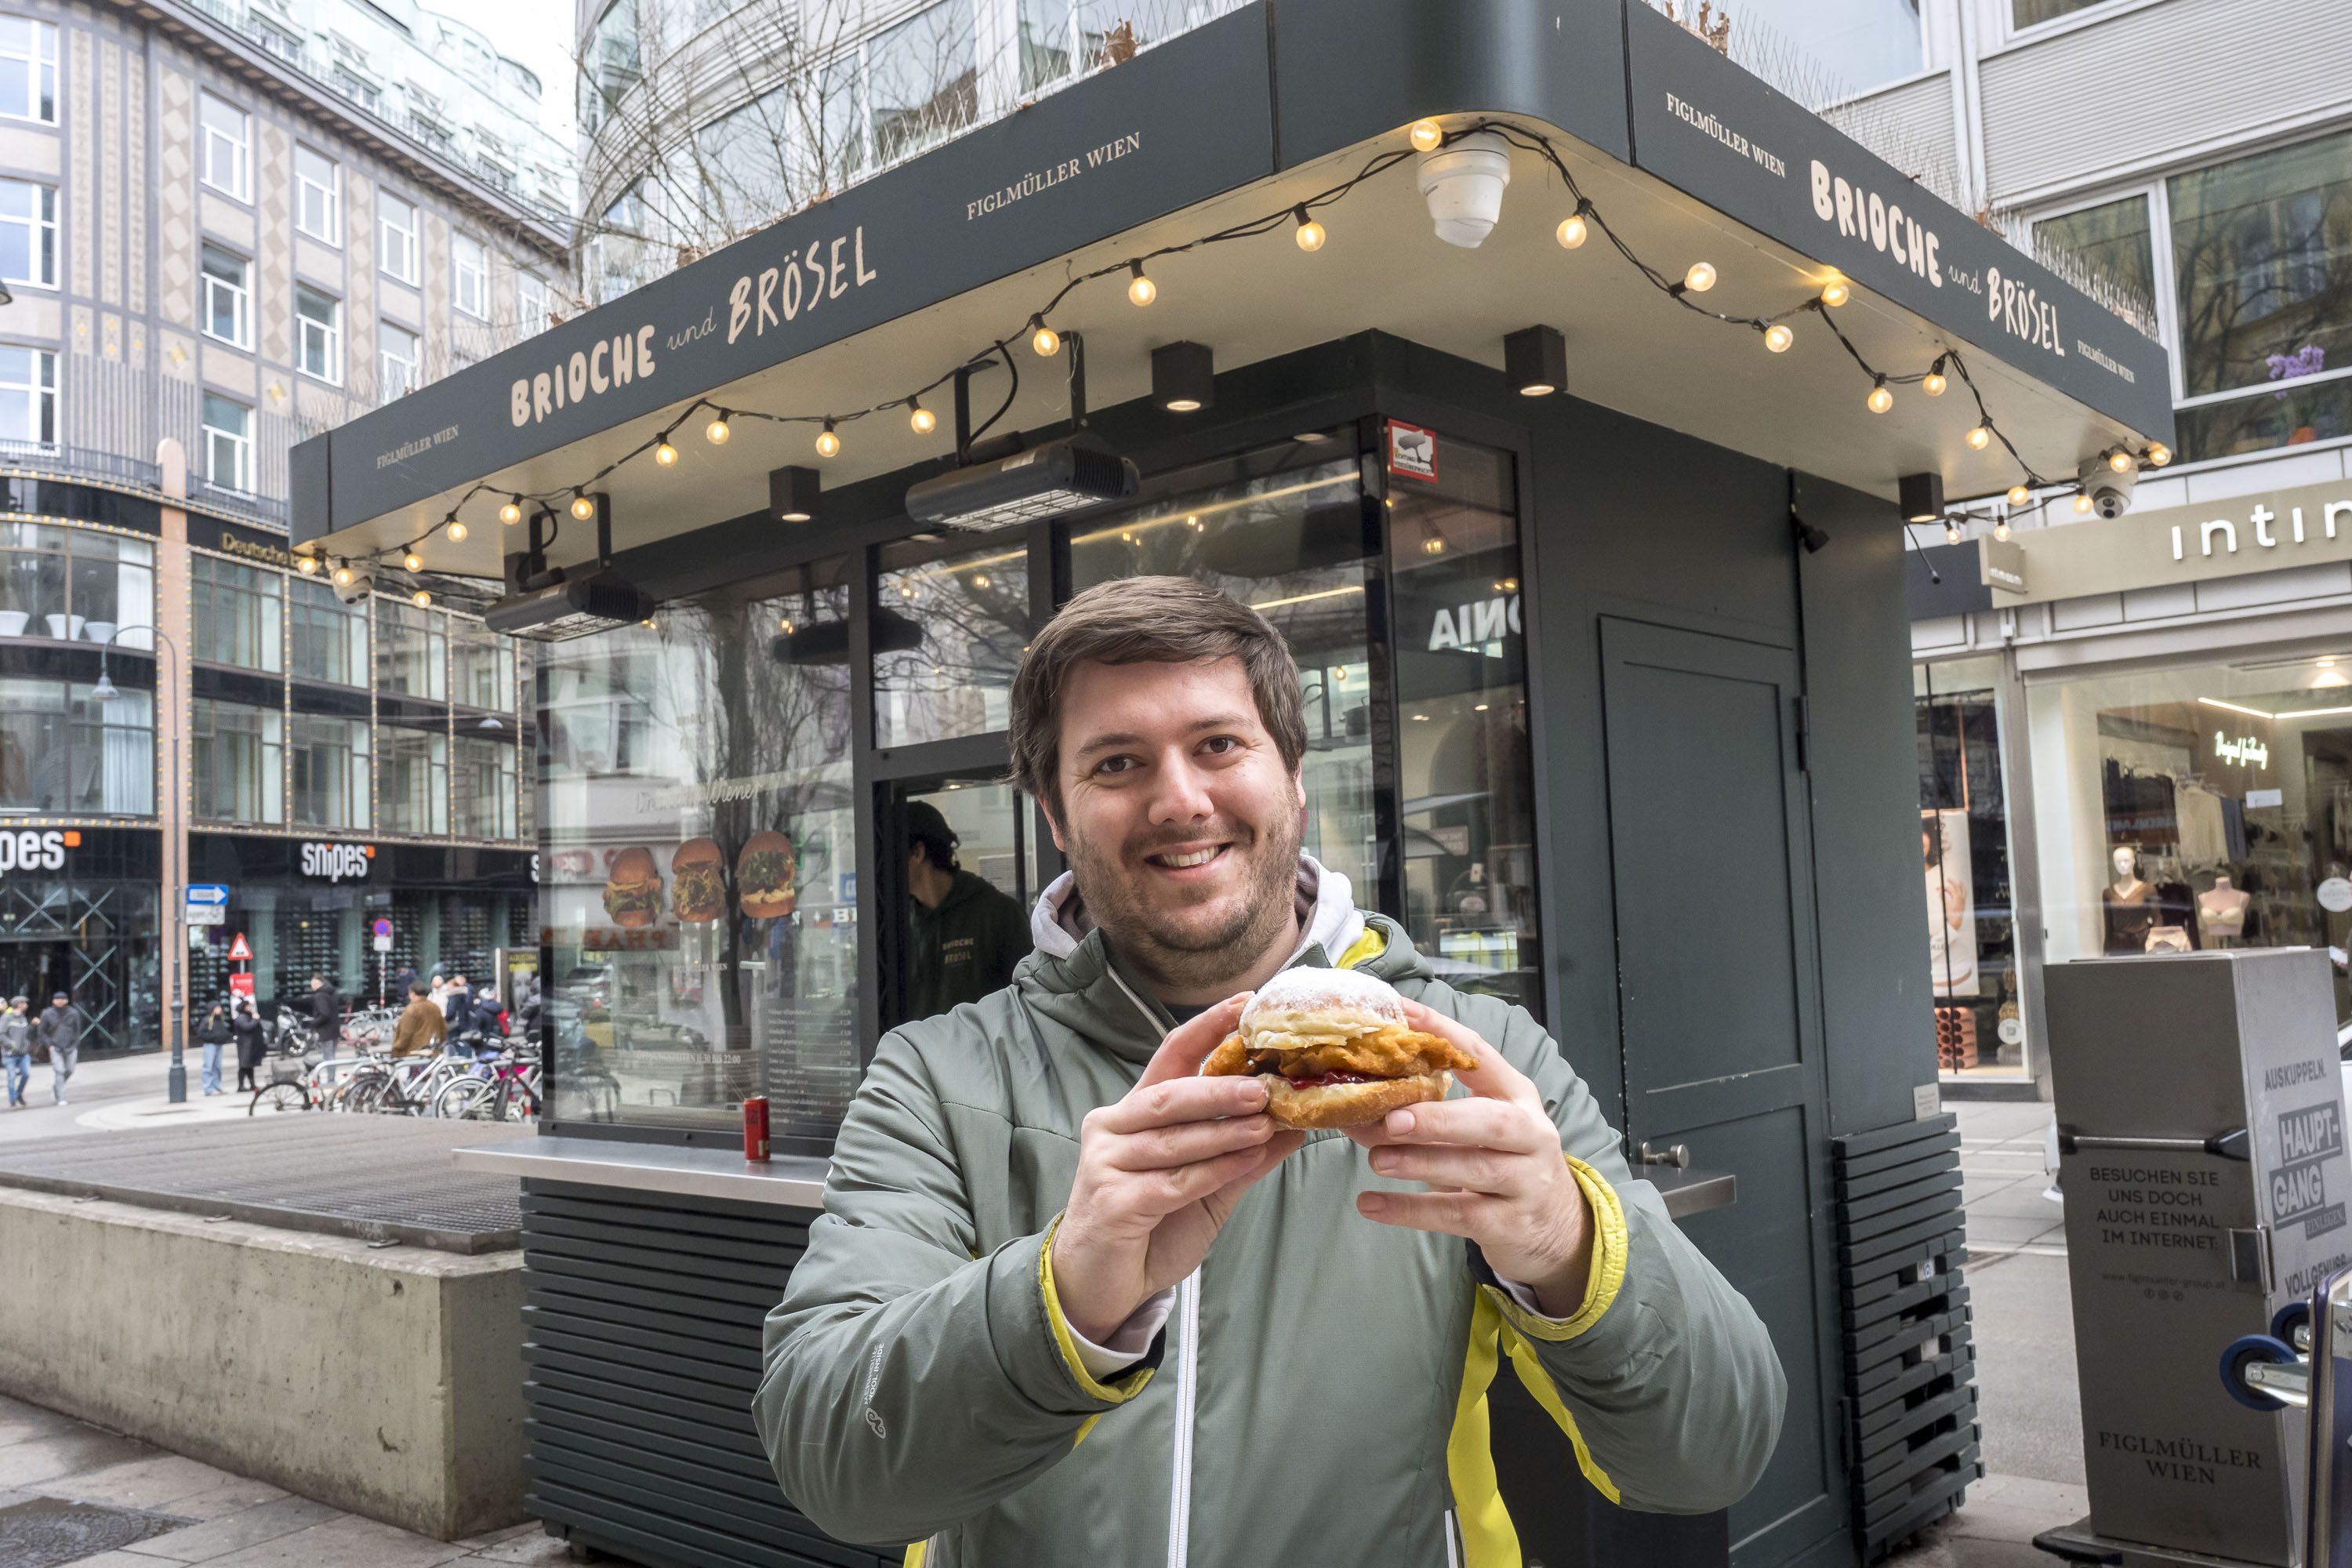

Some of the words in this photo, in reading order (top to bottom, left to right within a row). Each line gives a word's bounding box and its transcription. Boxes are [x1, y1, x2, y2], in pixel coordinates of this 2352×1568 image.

[1666, 93, 1750, 158] FIGLMÜLLER
[1751, 144, 1786, 179] WIEN
[967, 158, 1082, 221] FIGLMÜLLER
[1086, 132, 1141, 169] WIEN
[1810, 159, 1943, 289] BRIOCHE
[1948, 265, 1983, 295] und
[1987, 267, 2066, 358] BRÖSEL
[510, 324, 656, 428] BRIOCHE
[666, 305, 718, 350] und
[727, 225, 877, 345] BRÖSEL
[2077, 339, 2118, 375] FIGLMÜLLER
[2118, 363, 2135, 383] WIEN
[376, 436, 432, 470] FIGLMÜLLER
[433, 424, 459, 445] WIEN
[301, 842, 368, 884] snipes
[2264, 1058, 2328, 1092] AUSKUPPELN.
[2280, 1107, 2339, 1160] HAUPT-
[2089, 1167, 2182, 1185] BESUCHEN
[2187, 1171, 2220, 1186] SIE
[2273, 1164, 2322, 1216] GANG
[2096, 1208, 2145, 1225] AUCH
[2150, 1211, 2220, 1229] EINMAL
[2108, 1189, 2143, 1203] UNS
[2148, 1190, 2202, 1207] DOCH
[2102, 1229, 2125, 1244] IM
[873, 1341, 885, 1372] INSIDE
[2098, 1430, 2263, 1470] FIGLMÜLLER
[2145, 1458, 2216, 1485] WIEN
